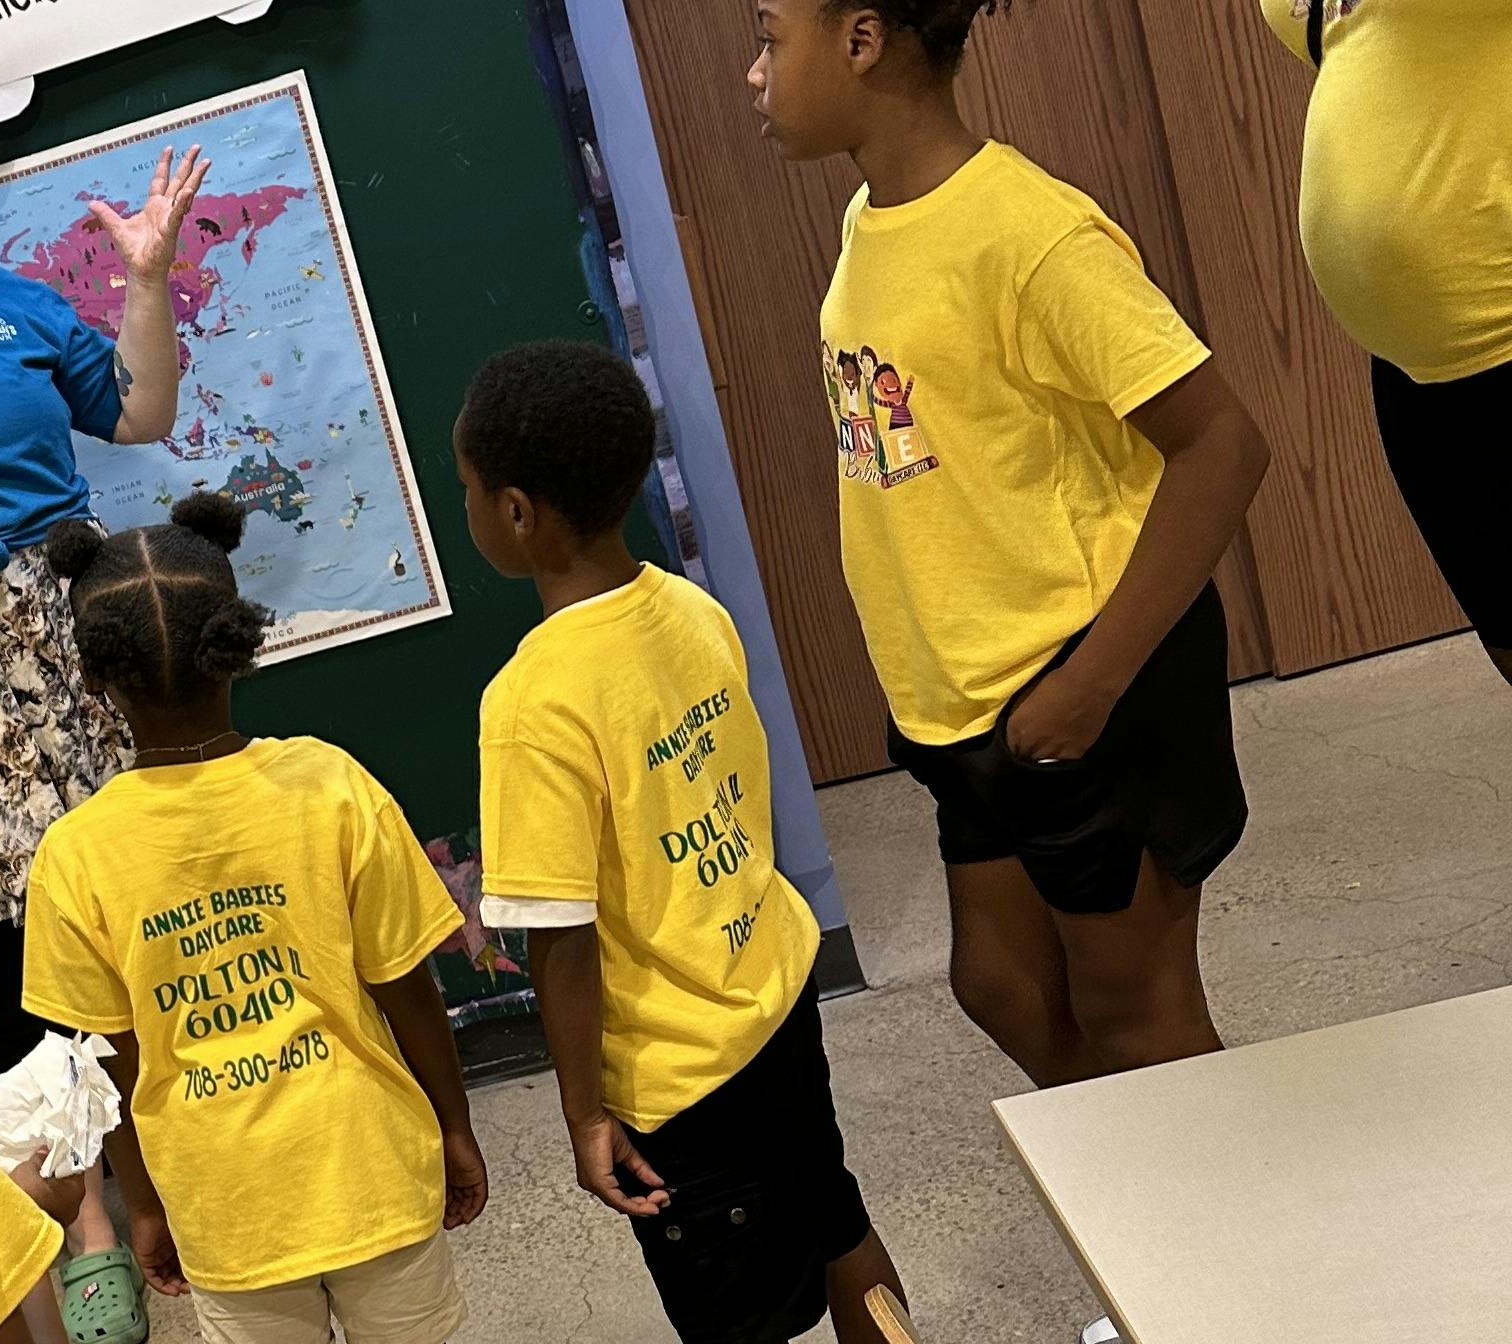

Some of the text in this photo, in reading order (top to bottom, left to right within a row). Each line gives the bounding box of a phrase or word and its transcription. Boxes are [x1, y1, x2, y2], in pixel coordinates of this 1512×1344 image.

[234, 482, 286, 503] Australia
[728, 772, 743, 804] IL
[141, 884, 287, 941] ANNIE BABIES
[180, 913, 264, 957] DAYCARE
[153, 945, 311, 1013] DOLTON IL
[186, 978, 295, 1039] 60419
[185, 1030, 329, 1101] 708-300-4678
